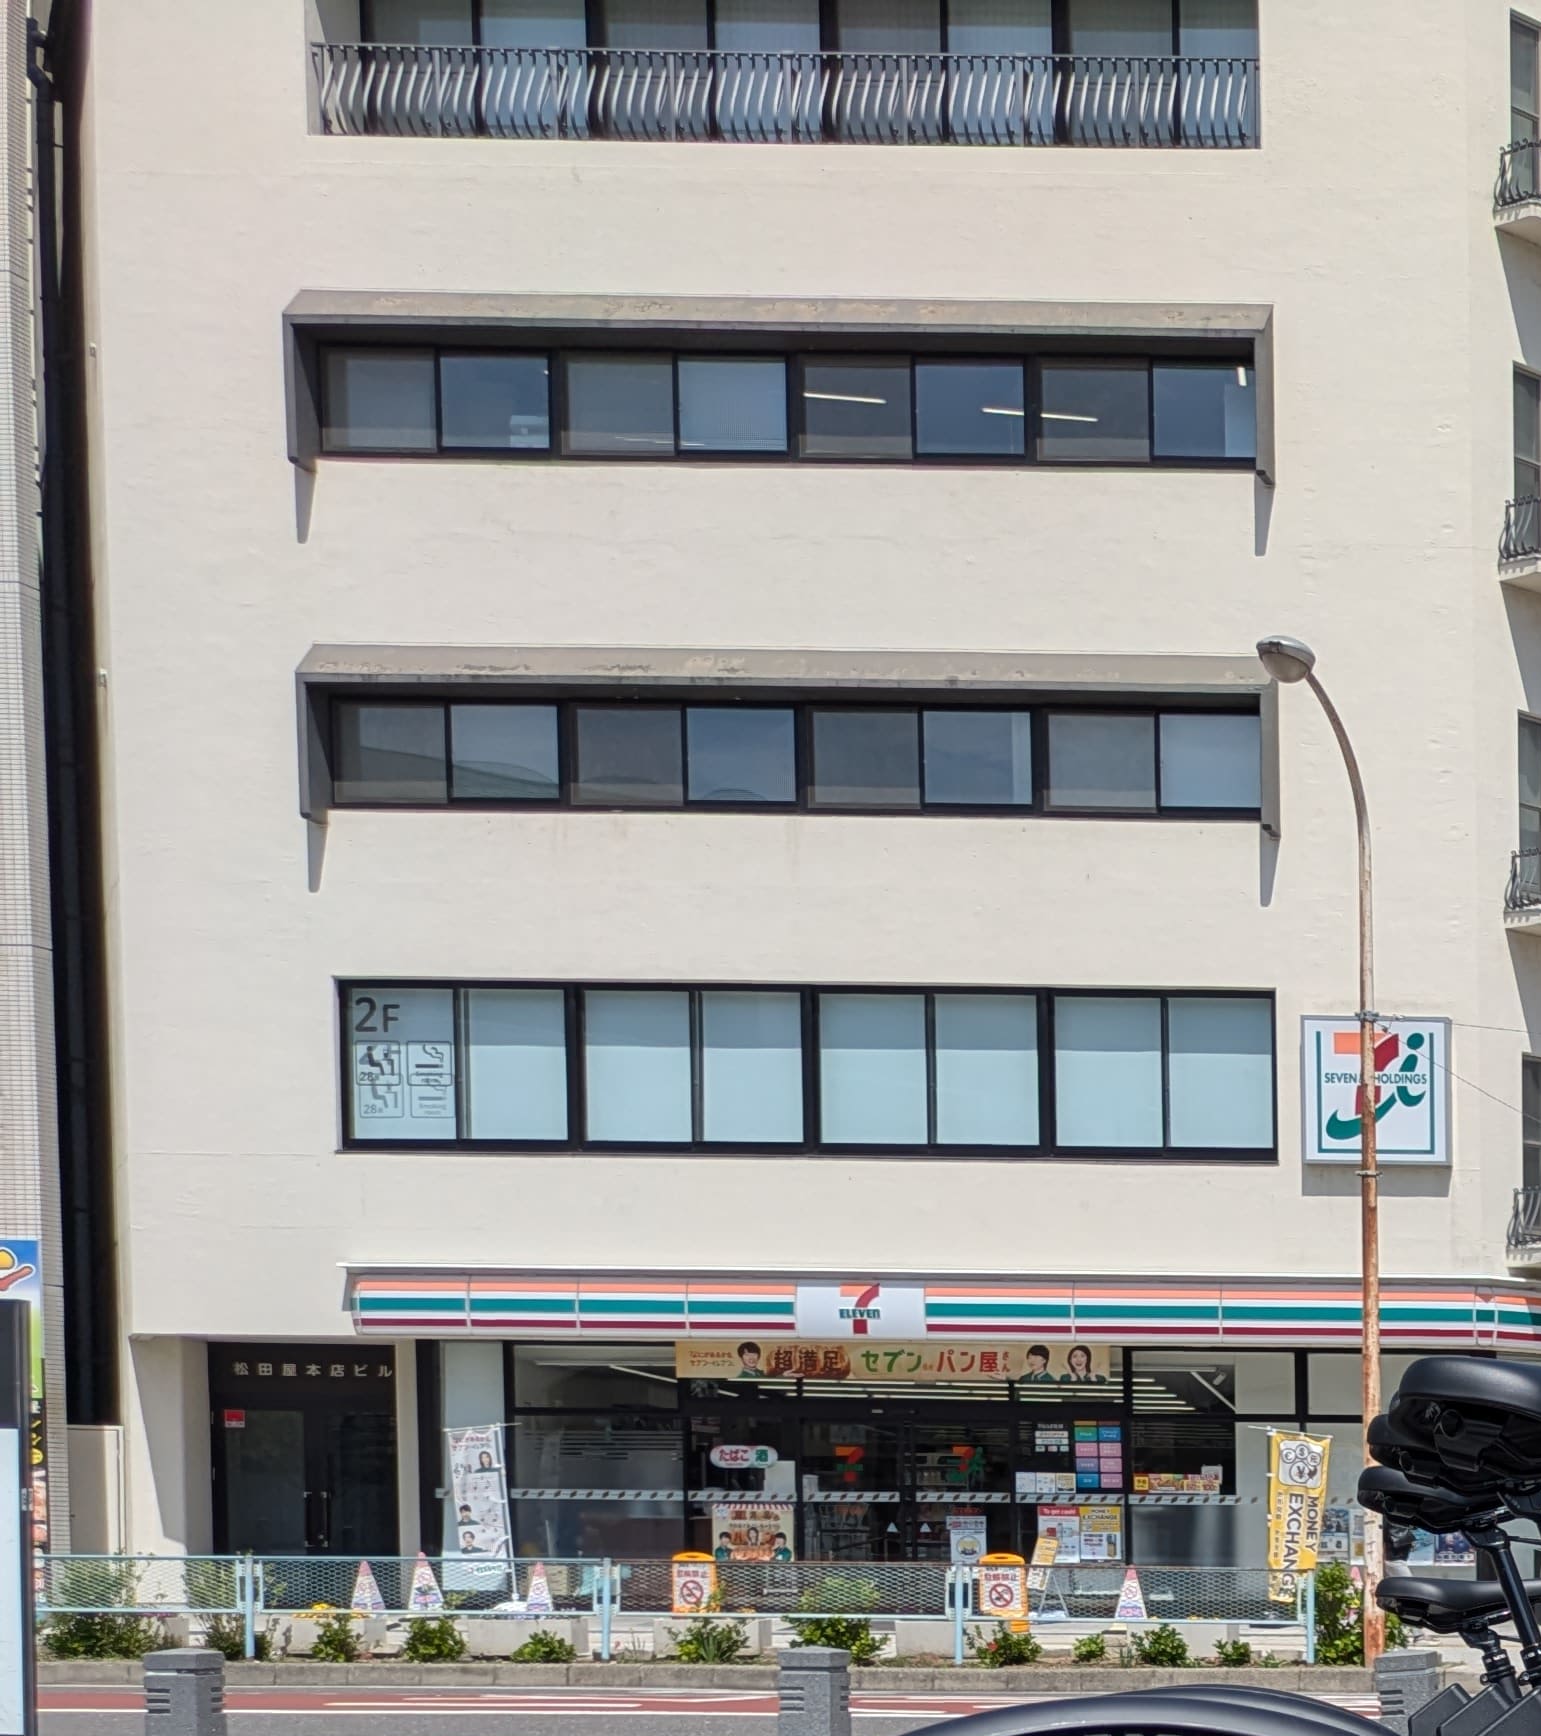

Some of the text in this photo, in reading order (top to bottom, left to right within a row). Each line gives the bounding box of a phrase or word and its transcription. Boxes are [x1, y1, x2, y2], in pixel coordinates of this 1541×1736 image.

[354, 996, 401, 1033] 2F
[1324, 1072, 1357, 1084] SEVEN
[231, 1361, 393, 1378] 松田屋本店ビル
[773, 1349, 843, 1374] 超満足
[860, 1349, 923, 1374] セブン
[718, 1448, 751, 1463] たばこ
[1304, 1495, 1320, 1553] MONEY
